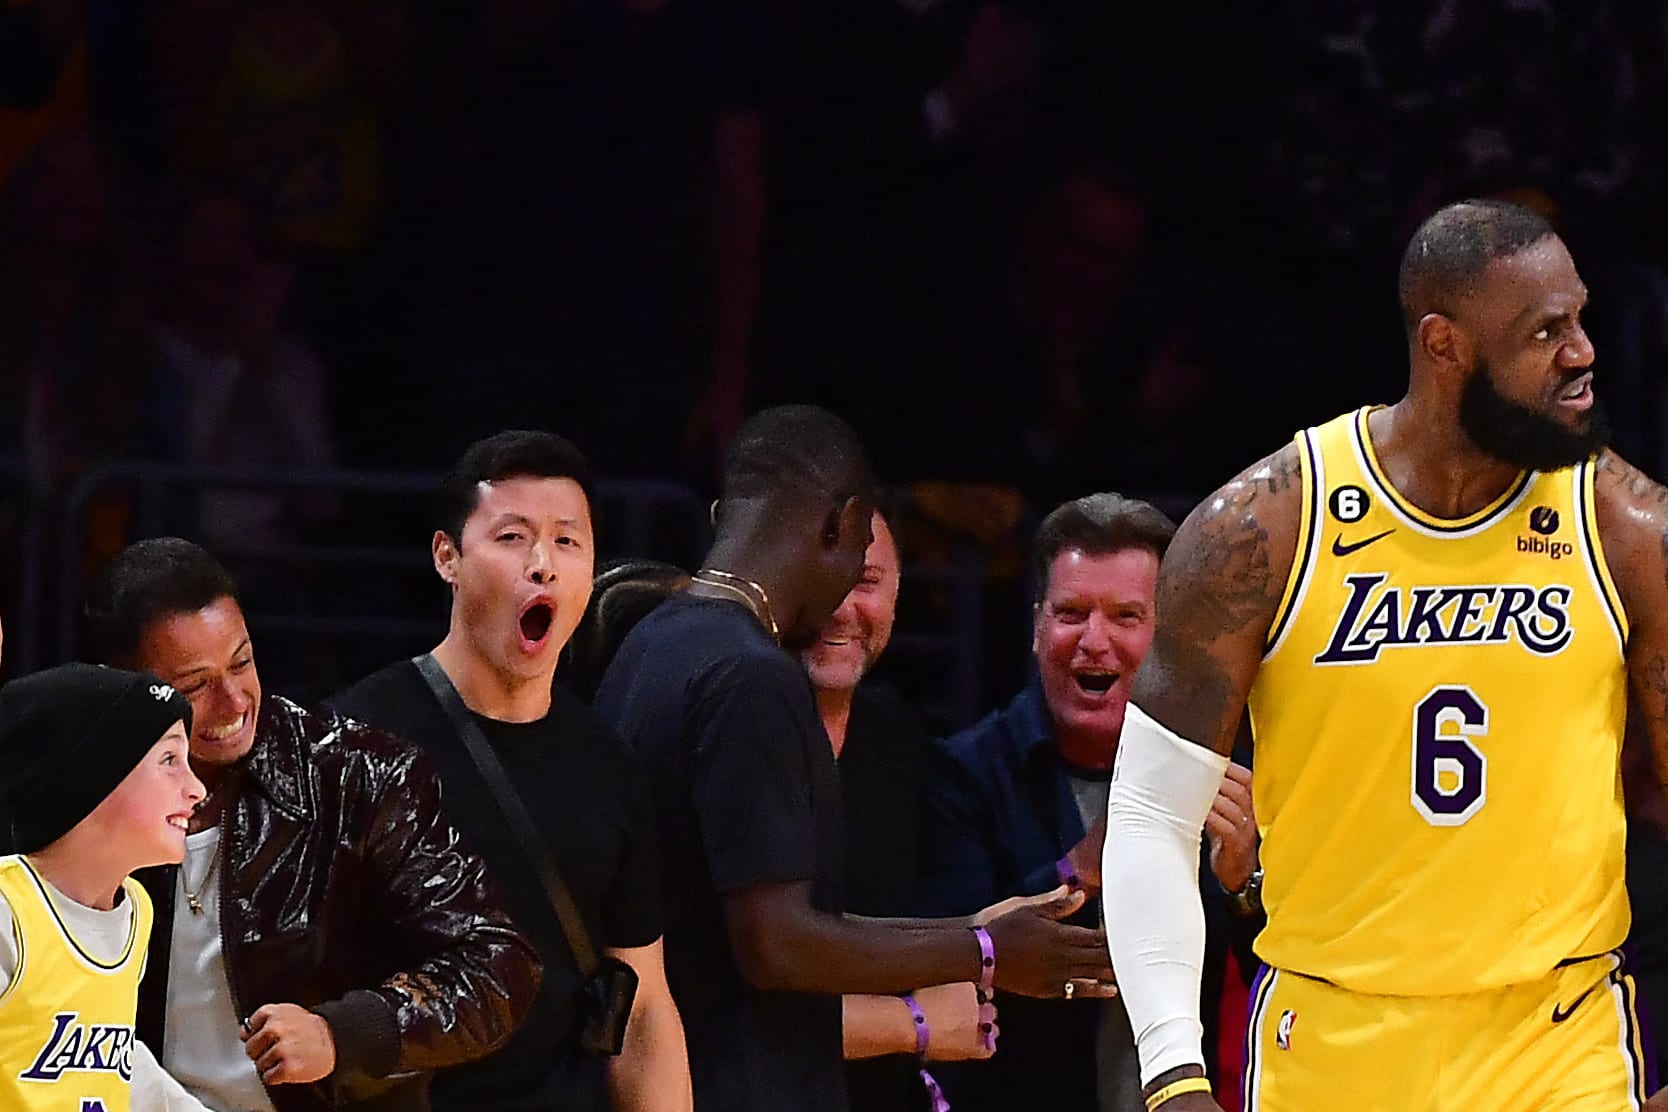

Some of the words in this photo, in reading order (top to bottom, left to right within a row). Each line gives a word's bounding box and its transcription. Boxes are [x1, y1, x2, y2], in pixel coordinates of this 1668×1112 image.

[1338, 489, 1360, 519] 6
[1516, 535, 1573, 560] bibigo
[1313, 572, 1575, 666] LAKERS
[1411, 684, 1489, 827] 6
